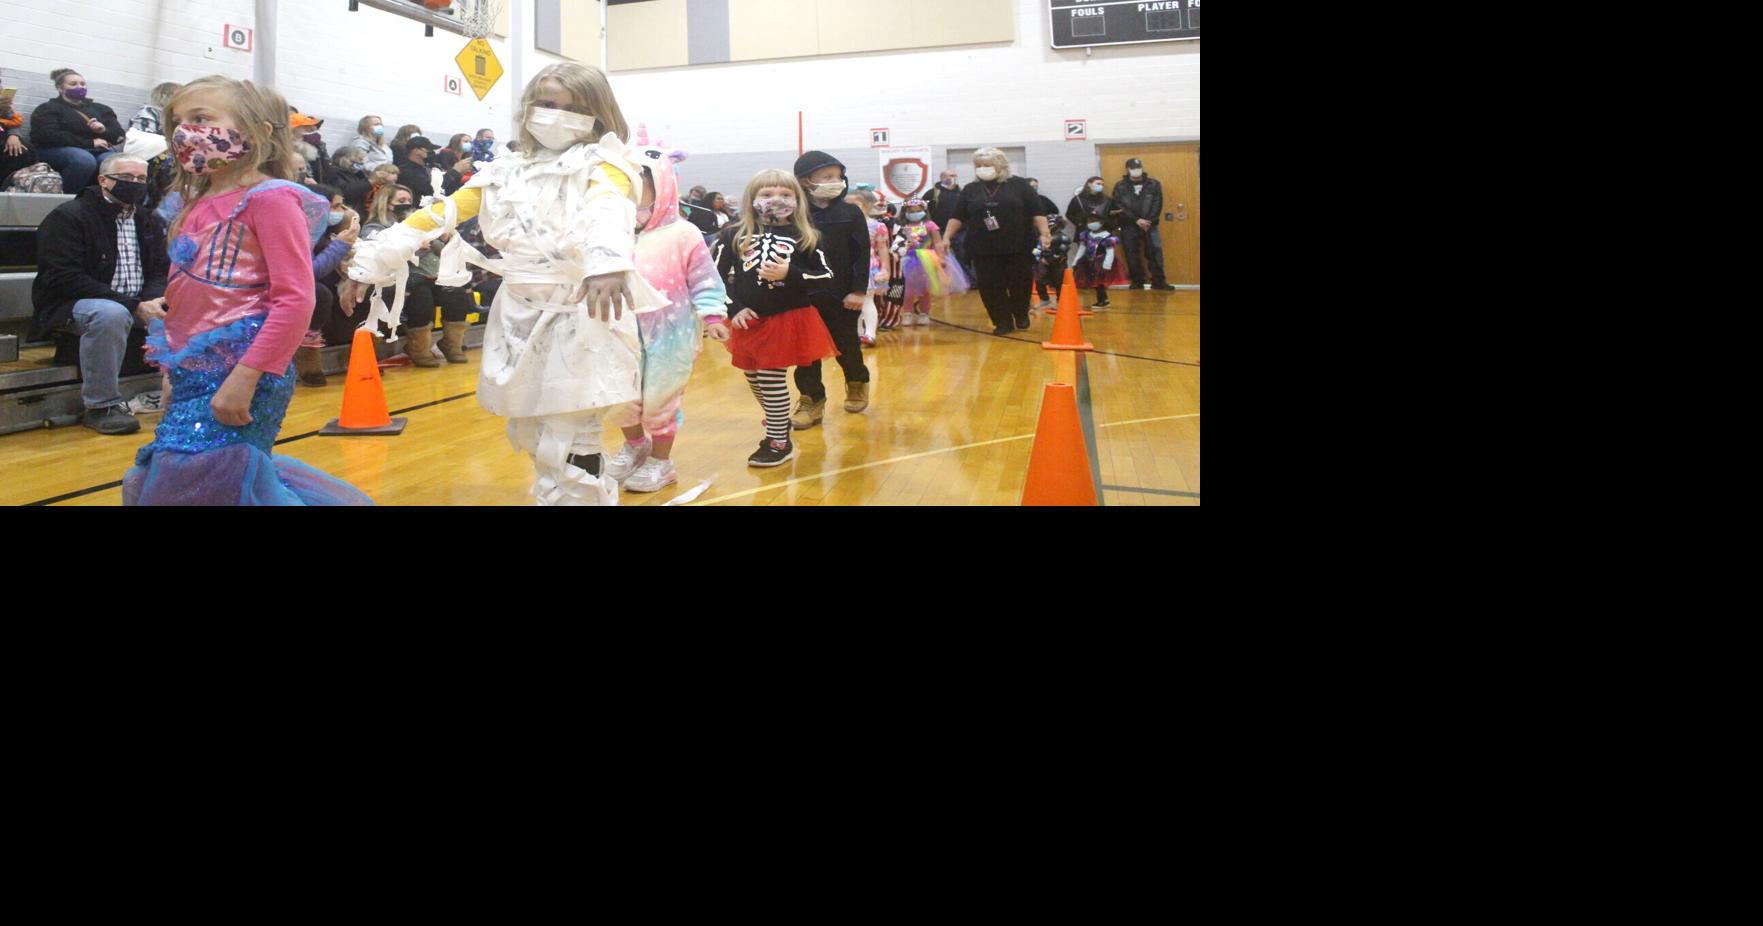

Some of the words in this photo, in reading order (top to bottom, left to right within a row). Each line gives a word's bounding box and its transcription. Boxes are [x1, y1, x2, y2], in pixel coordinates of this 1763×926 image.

[1071, 7, 1104, 17] FOULS
[1138, 1, 1179, 12] PLAYER
[1068, 123, 1082, 135] 2
